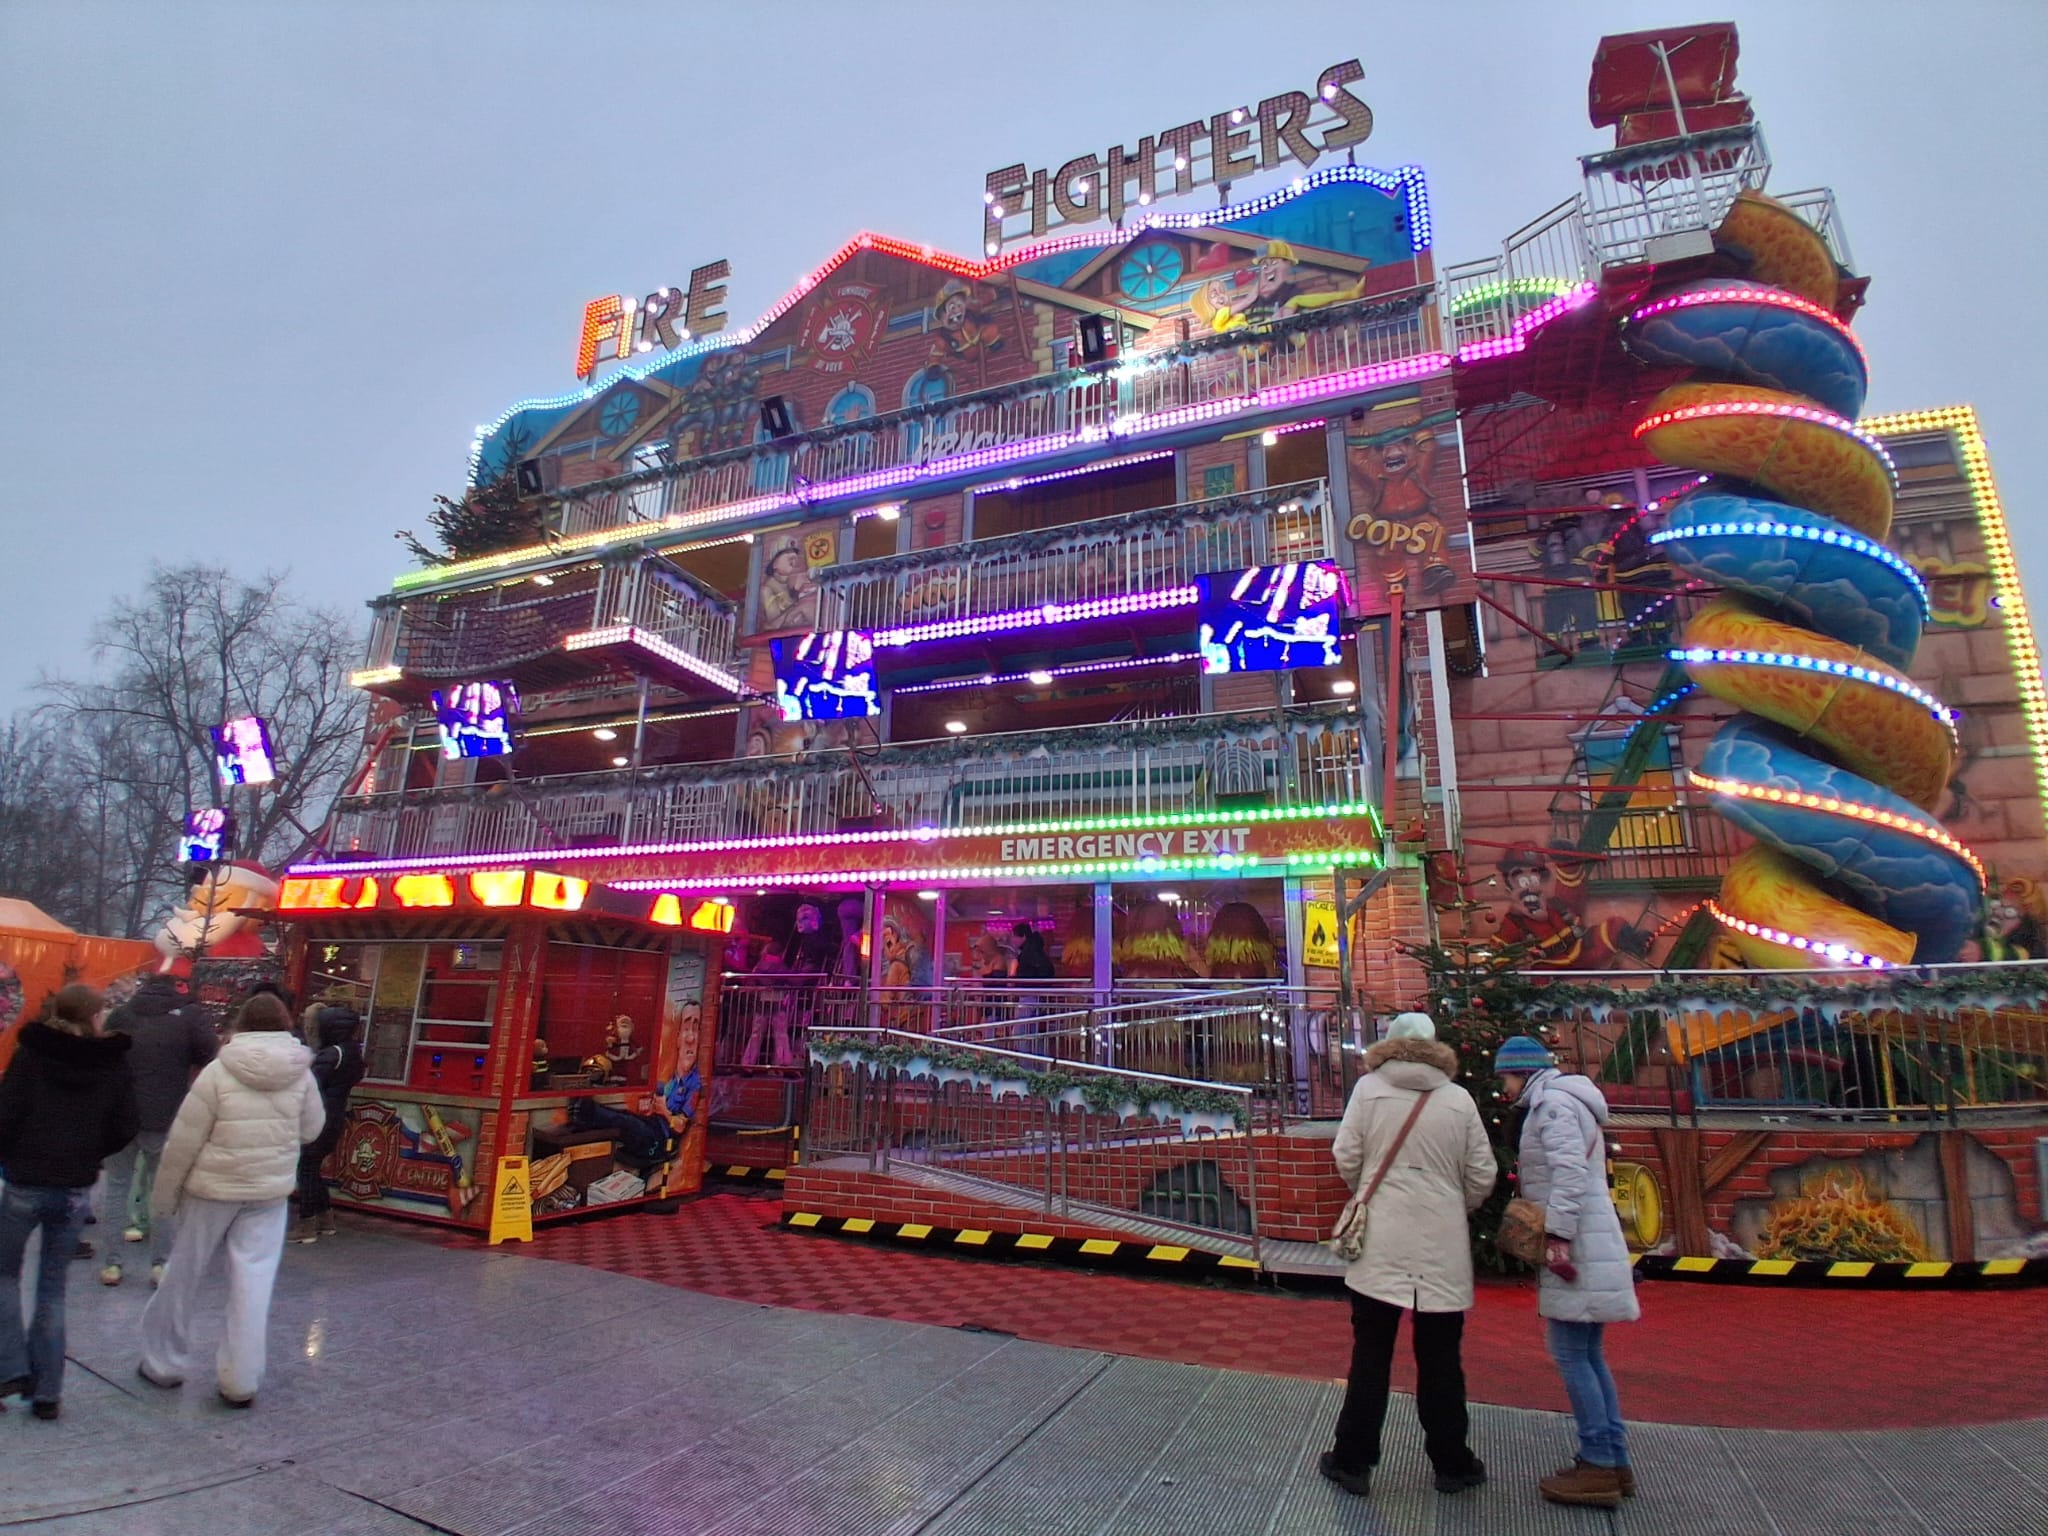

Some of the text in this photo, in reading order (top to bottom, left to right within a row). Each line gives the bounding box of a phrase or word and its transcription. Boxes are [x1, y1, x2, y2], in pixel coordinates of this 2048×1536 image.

[577, 58, 1374, 380] FIRE FIGHTERS
[1002, 828, 1251, 861] EMERGENCY EXIT
